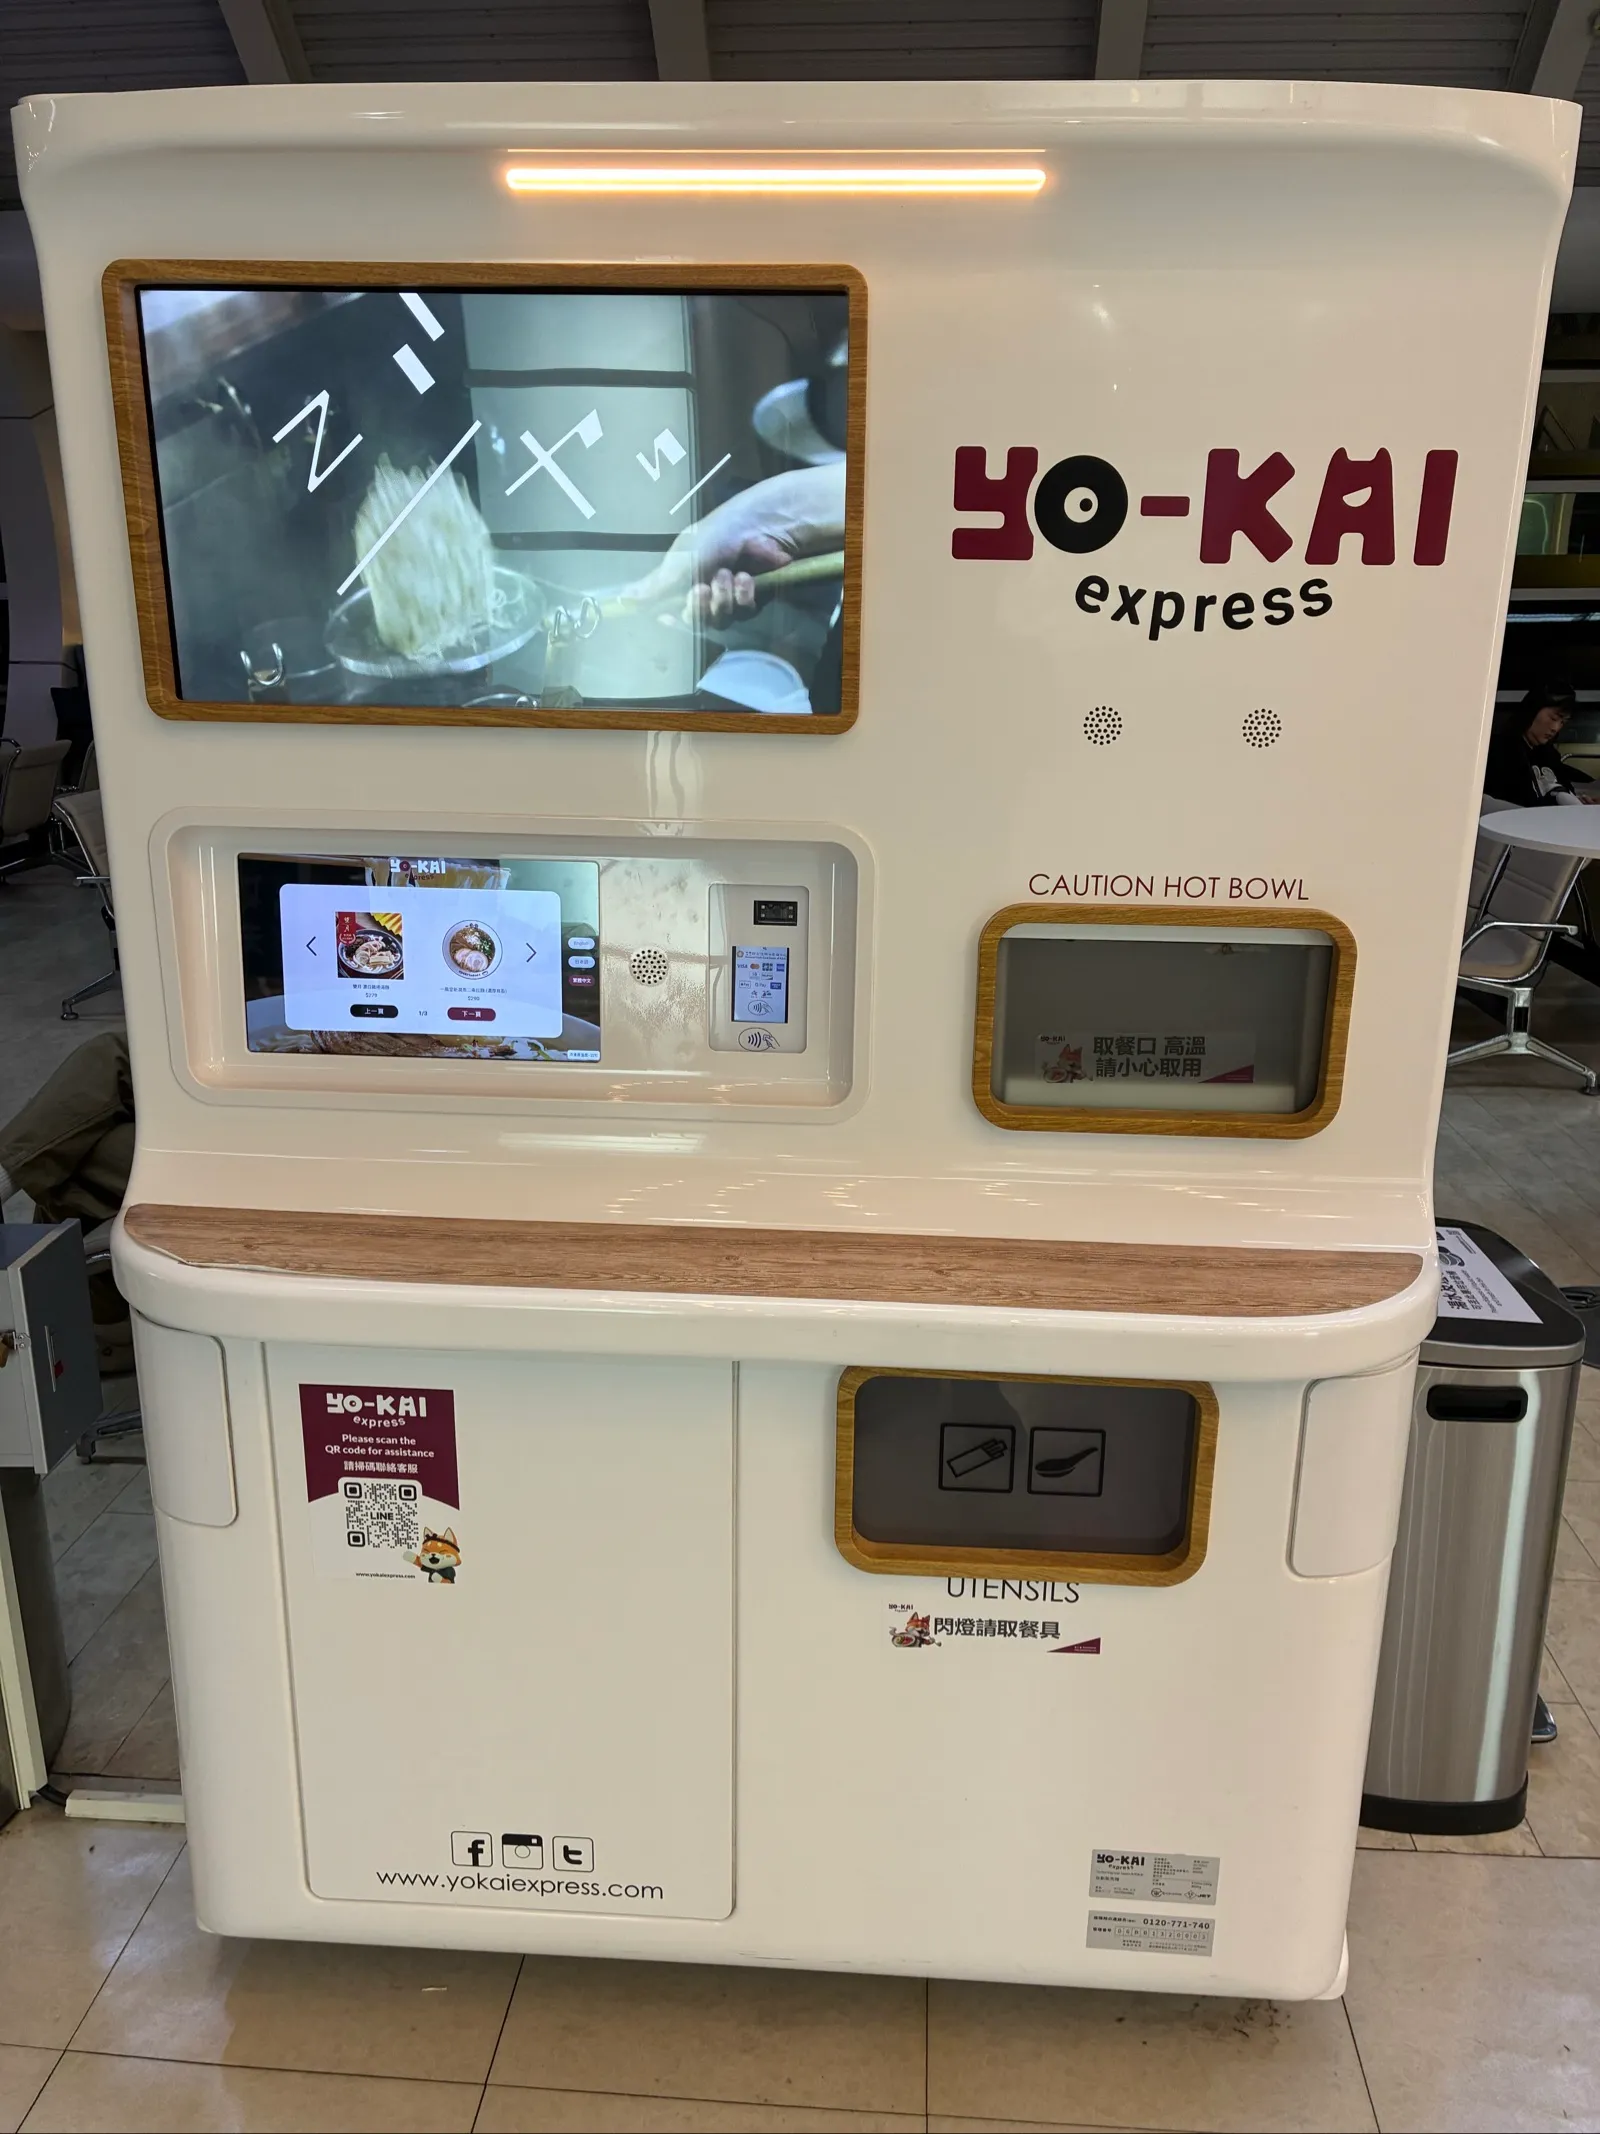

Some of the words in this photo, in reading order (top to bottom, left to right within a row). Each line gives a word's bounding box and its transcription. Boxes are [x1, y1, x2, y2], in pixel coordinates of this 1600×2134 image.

[951, 446, 1459, 566] YO-KAI
[1075, 575, 1333, 641] express
[390, 859, 446, 874] YO-KAI
[1029, 873, 1154, 897] CAUTION
[1164, 876, 1220, 898] HOT
[1229, 877, 1309, 900] BOWL
[1093, 1036, 1157, 1056] 取餐口
[1164, 1036, 1206, 1056] 高溫
[1095, 1057, 1202, 1078] 請小心取用
[326, 1392, 427, 1418] YO-KAI
[353, 1415, 406, 1429] express
[342, 1434, 374, 1445] Please
[375, 1436, 398, 1445] scan
[400, 1436, 416, 1446] the
[325, 1445, 341, 1454] QR
[343, 1446, 366, 1456] code
[368, 1446, 382, 1456] for
[384, 1448, 435, 1458] assistance
[343, 1460, 418, 1474] 請掃碼聯絡客服
[370, 1511, 394, 1521] LINE
[355, 1571, 416, 1580] www.yokaiexpress.com
[947, 1577, 1080, 1604] UTENSILS
[934, 1617, 1061, 1640] 閃燈請取餐具
[1096, 1853, 1145, 1866] YO-KAI
[376, 1871, 664, 1900] www.yokaiexpress.com
[1143, 1918, 1210, 1930] 0120-771-740
